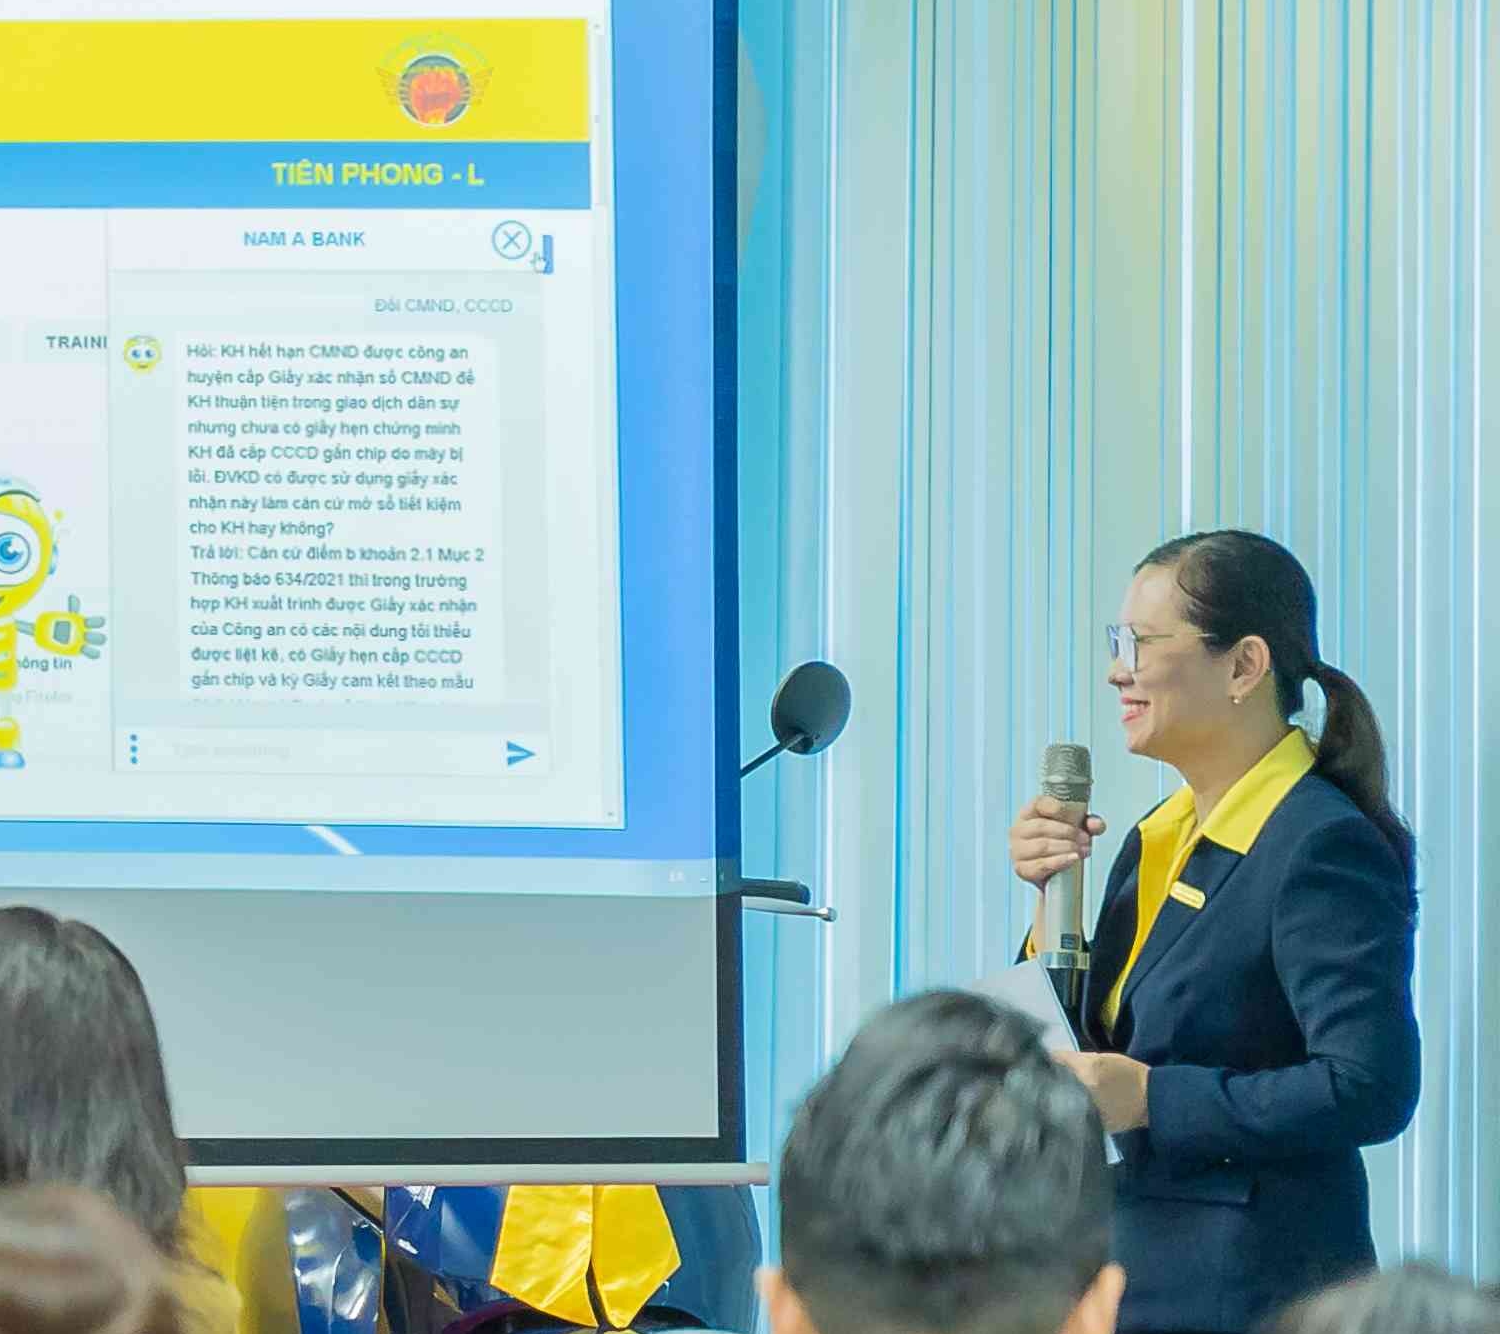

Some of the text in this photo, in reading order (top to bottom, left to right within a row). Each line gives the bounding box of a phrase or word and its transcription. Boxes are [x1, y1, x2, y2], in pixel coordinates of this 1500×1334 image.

[342, 162, 443, 186] PHONG
[468, 163, 484, 185] L
[244, 231, 366, 247] NAM A BANK
[466, 299, 513, 313] CCCD
[220, 345, 245, 359] KH
[308, 345, 360, 359] CMND
[449, 349, 469, 360] an
[188, 396, 211, 409] KH
[292, 397, 331, 413] trong
[335, 398, 367, 413] giao
[189, 522, 216, 535] cho
[220, 522, 245, 535] KH
[249, 522, 275, 538] hay
[275, 573, 344, 587] 634/2021
[372, 574, 410, 590] trong
[53, 656, 73, 670] tin
